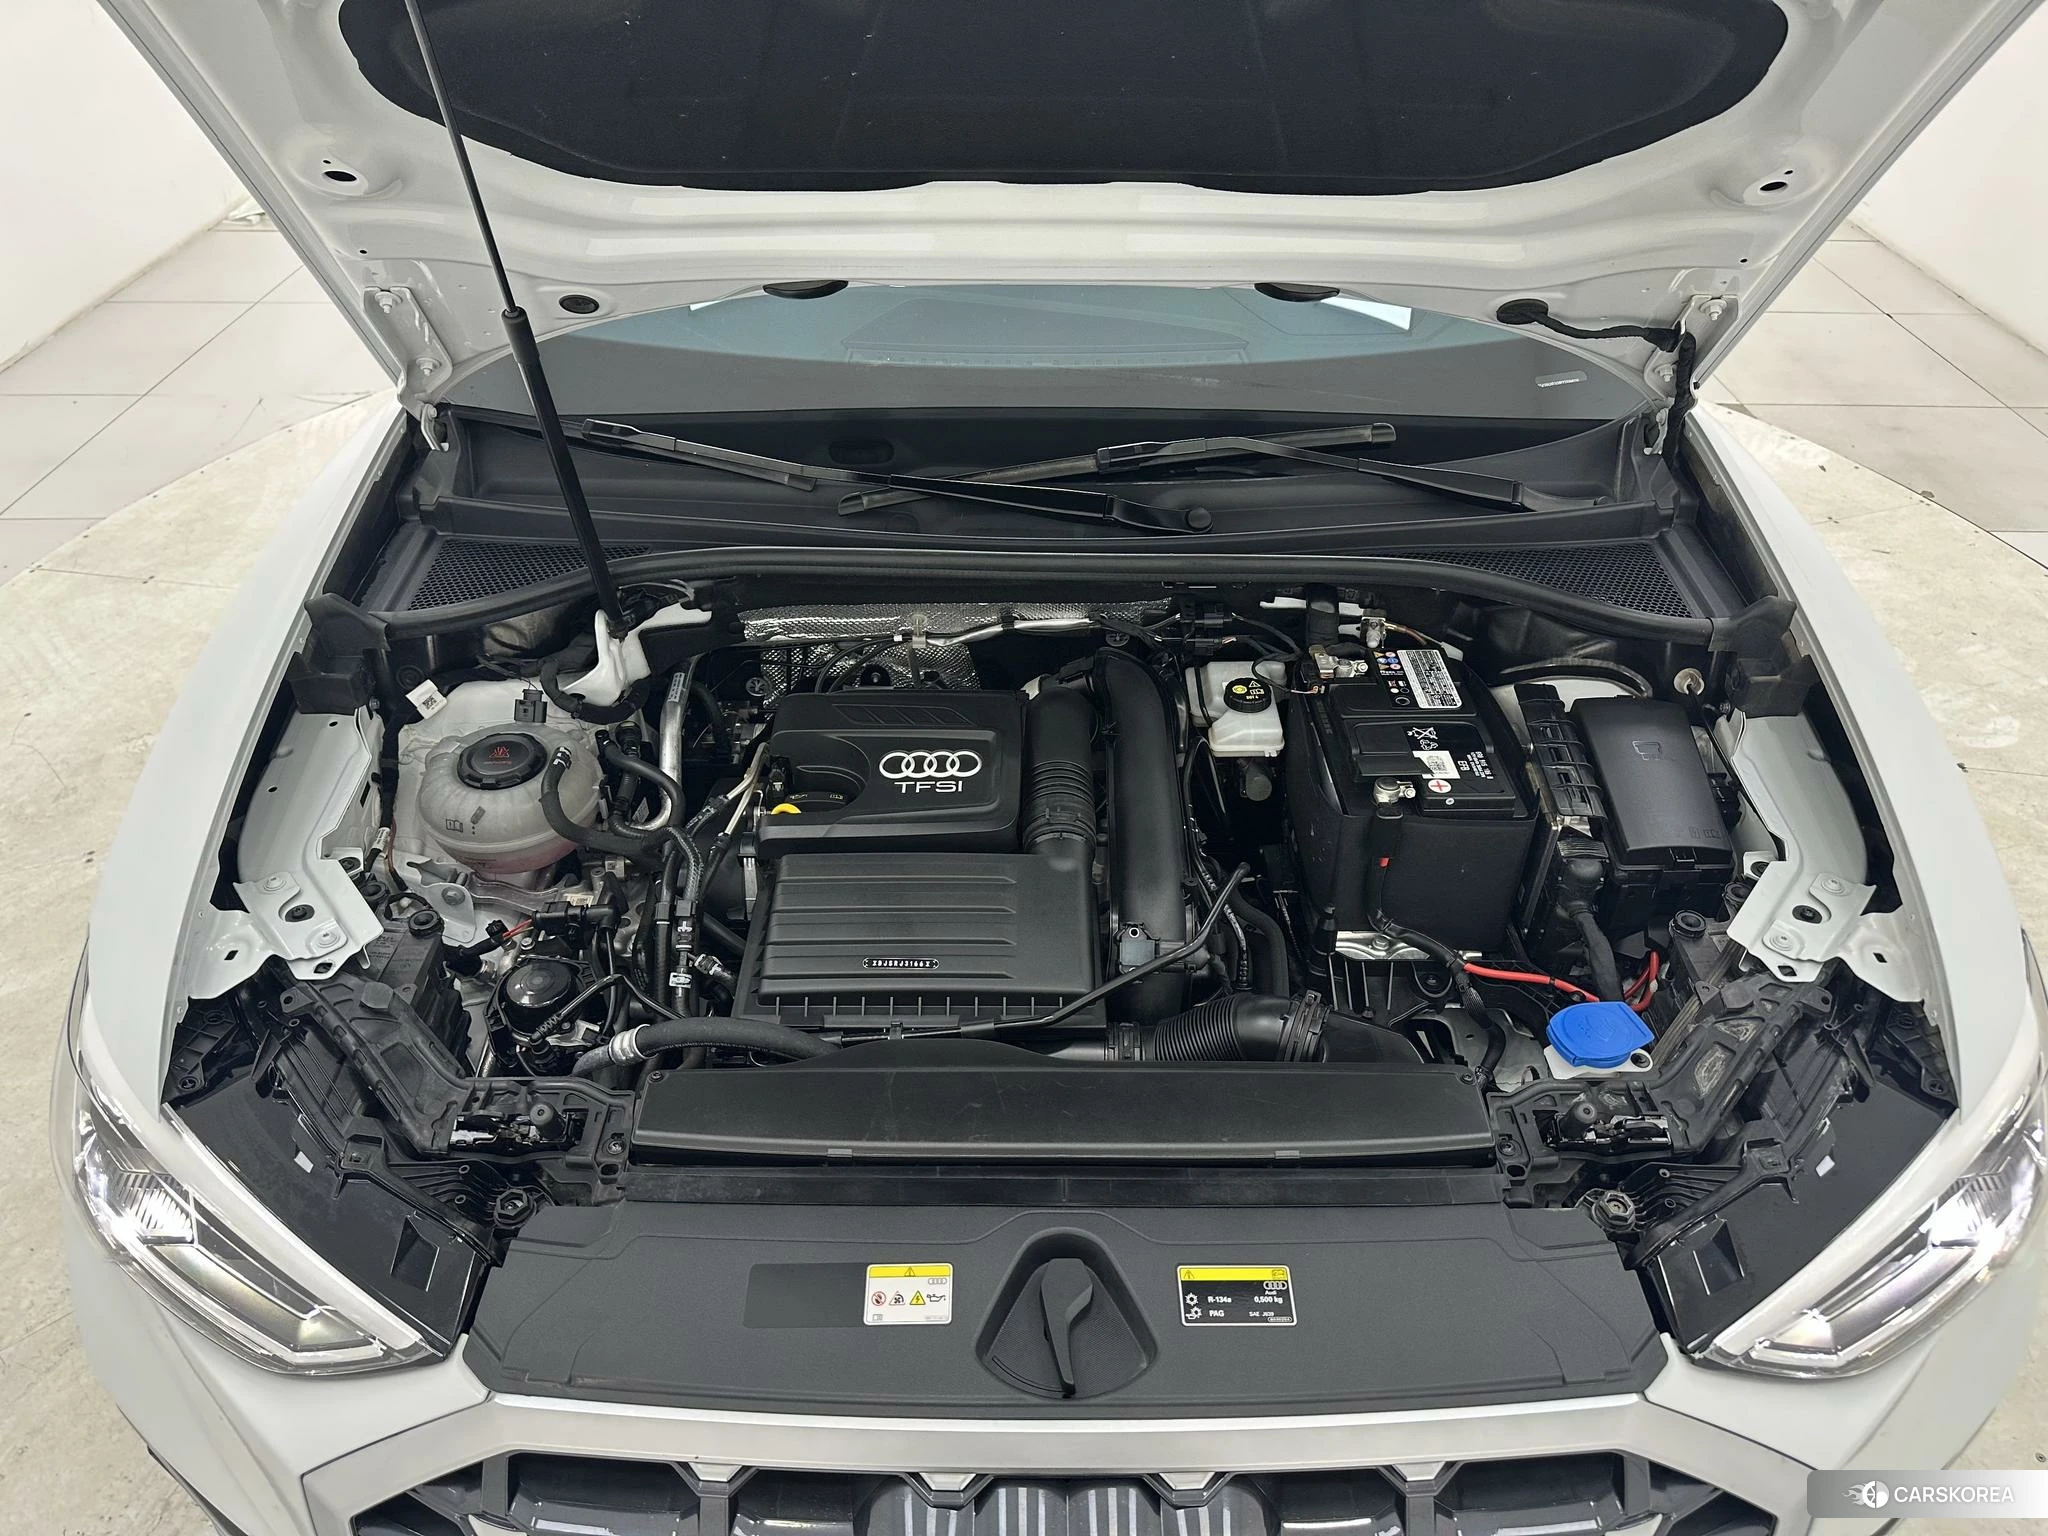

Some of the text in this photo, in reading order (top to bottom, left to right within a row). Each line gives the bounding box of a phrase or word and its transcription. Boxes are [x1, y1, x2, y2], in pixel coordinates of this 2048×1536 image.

[894, 780, 963, 794] TFSI
[1253, 1296, 1273, 1304] 0,500
[1273, 1296, 1284, 1305] kg
